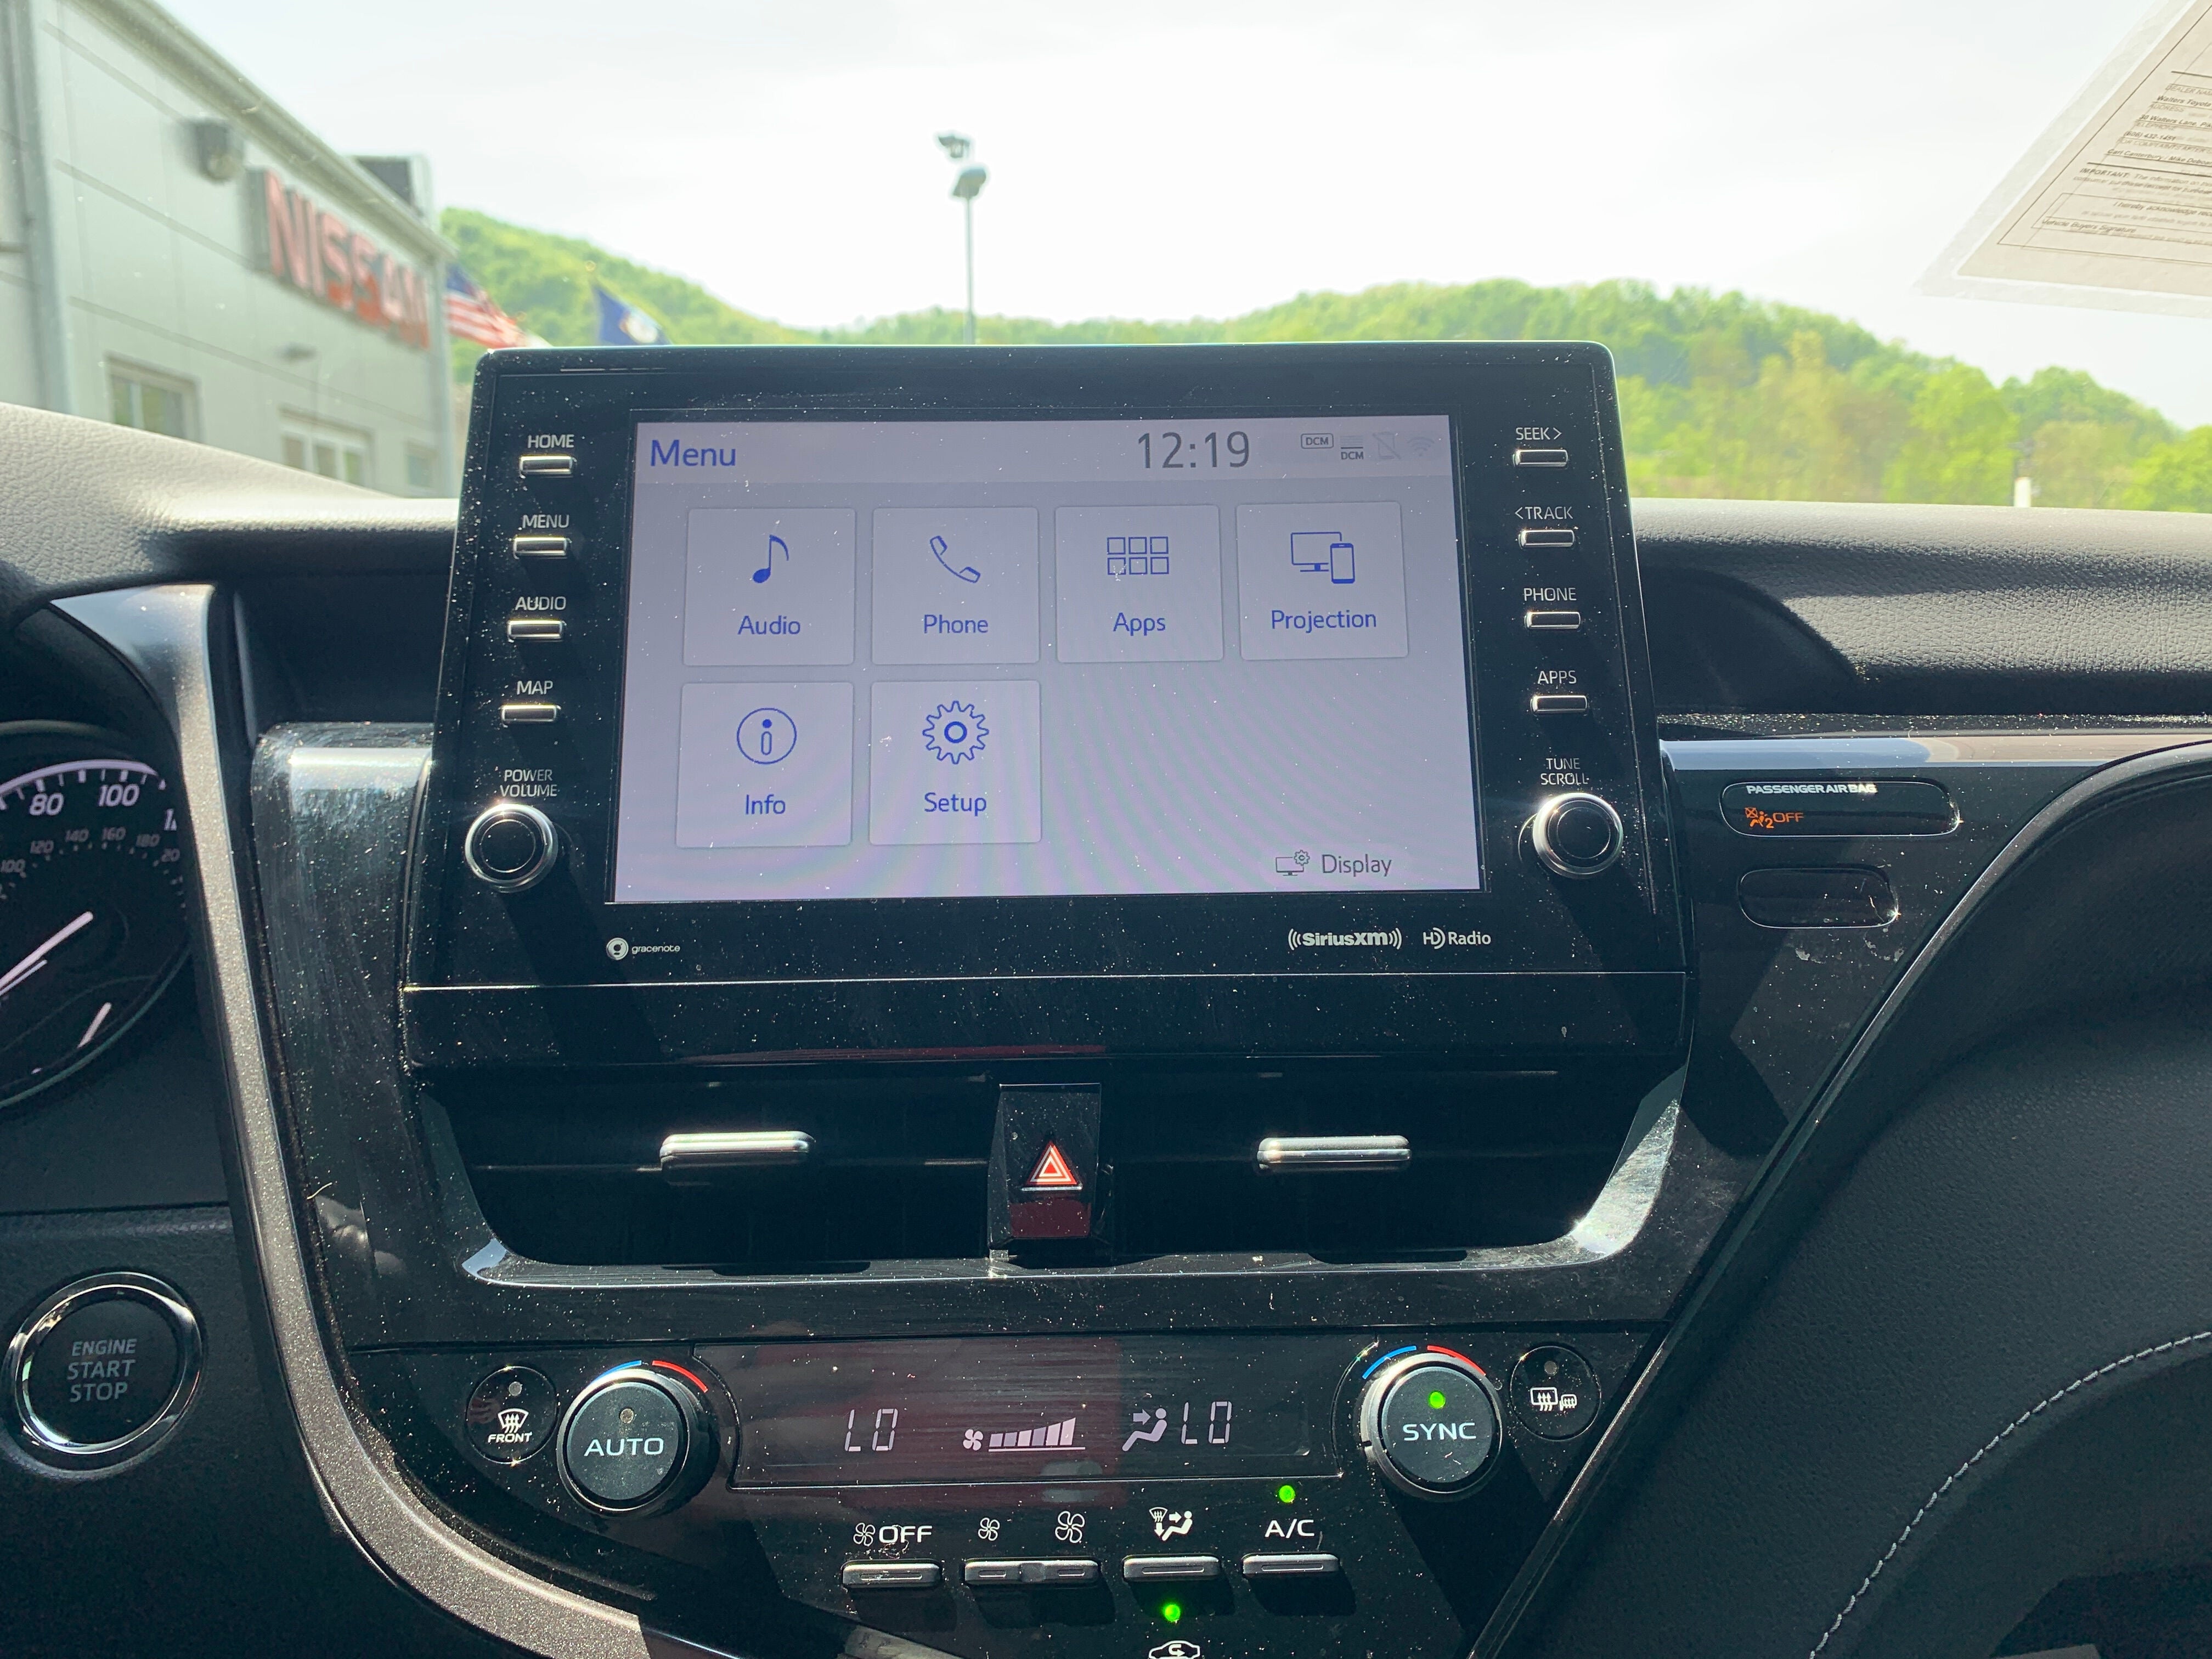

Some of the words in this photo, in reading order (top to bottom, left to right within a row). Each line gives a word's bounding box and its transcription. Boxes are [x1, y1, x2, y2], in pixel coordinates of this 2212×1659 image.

[2157, 95, 2185, 104] Walters
[264, 170, 432, 352] NISSAN
[527, 434, 575, 448] HOME
[1137, 431, 1250, 469] 12:19
[1305, 436, 1329, 446] DCM
[650, 439, 737, 467] Menu
[1340, 450, 1364, 460] DCM
[522, 514, 570, 529] MENU
[515, 596, 567, 611] AUDIO
[1523, 588, 1577, 601] PHONE
[737, 614, 801, 635] Audio
[923, 613, 989, 635] Phone
[1113, 612, 1166, 636] Apps
[1271, 608, 1377, 634] Projection
[1537, 670, 1577, 684] APPS
[516, 680, 554, 695] MAP
[1546, 758, 1581, 770] TUNE
[504, 769, 553, 782] POWER
[1540, 773, 1588, 786] SCROLL
[97, 783, 140, 806] 100
[500, 785, 558, 797] VOLUME
[1746, 785, 1825, 794] PASSENGER
[1826, 785, 1848, 793] AIR
[1848, 783, 1877, 793] BAG
[29, 792, 64, 816] 80
[745, 793, 786, 815] Info
[924, 792, 988, 816] Setup
[1773, 812, 1804, 822] OFF
[1322, 853, 1392, 877] Display
[1448, 931, 1491, 945] Radio
[631, 943, 680, 954] gracenote
[71, 1338, 137, 1357] ENGINE
[66, 1359, 136, 1380] START
[70, 1381, 128, 1403] STOP
[488, 1431, 532, 1443] FRONT
[1403, 1422, 1476, 1442] SYNC
[584, 1437, 664, 1457] AUTO
[878, 1525, 933, 1543] OFF
[1265, 1519, 1315, 1539] A/C
